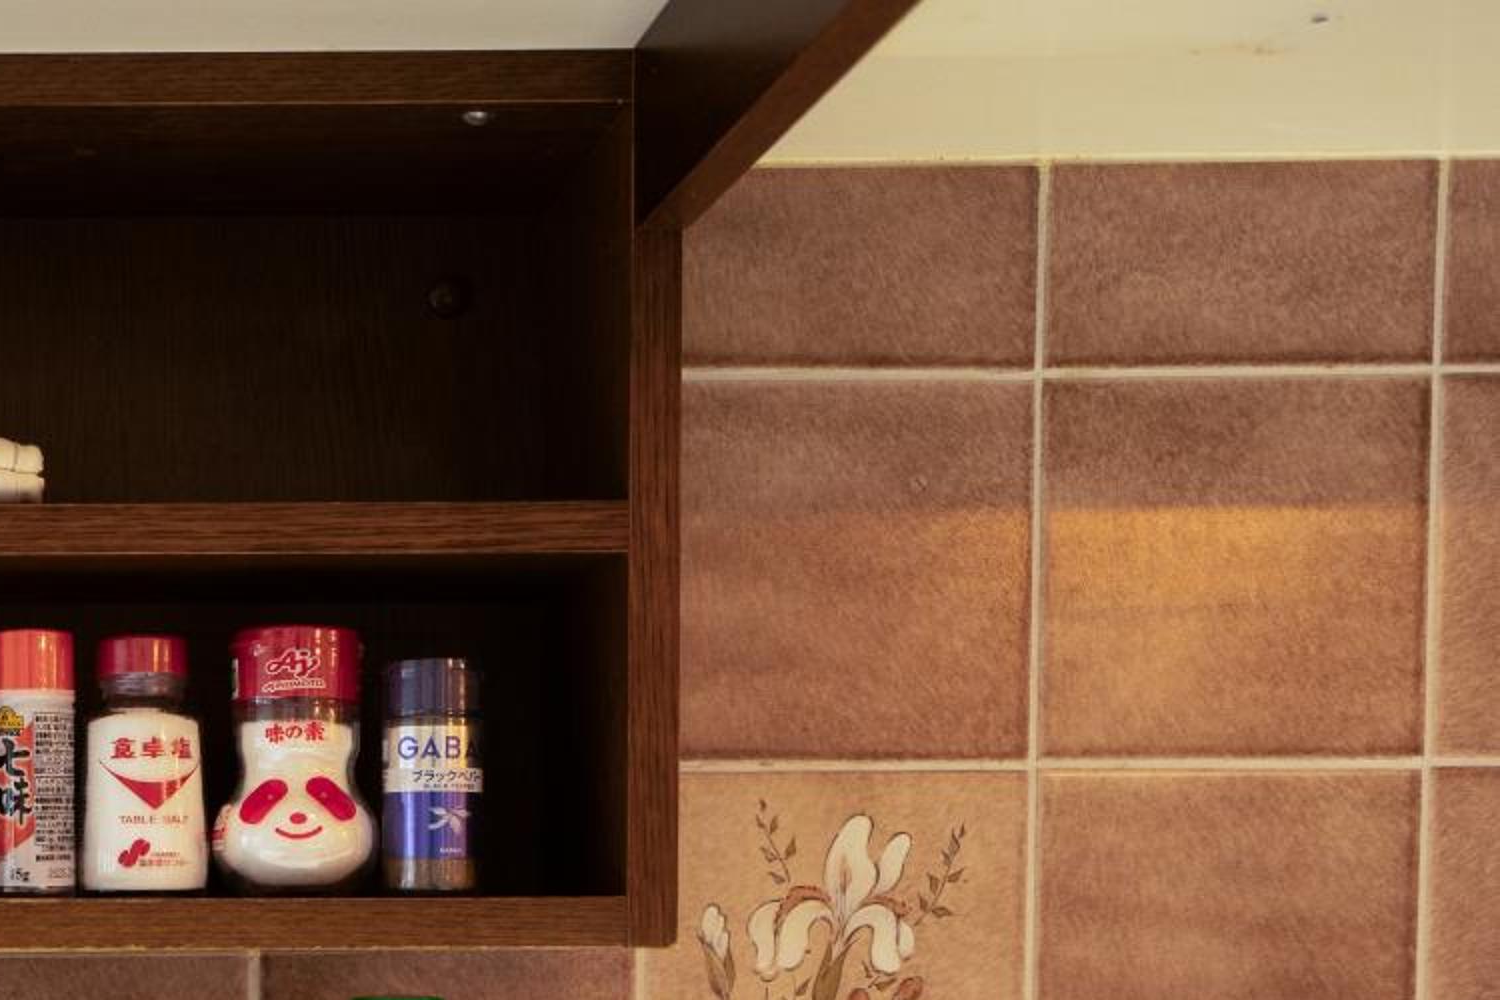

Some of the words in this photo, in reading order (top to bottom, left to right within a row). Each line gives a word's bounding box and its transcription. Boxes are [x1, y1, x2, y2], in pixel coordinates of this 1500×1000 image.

[265, 721, 325, 744] 味の素
[111, 736, 192, 759] 食卓塩
[119, 815, 157, 825] TABLE
